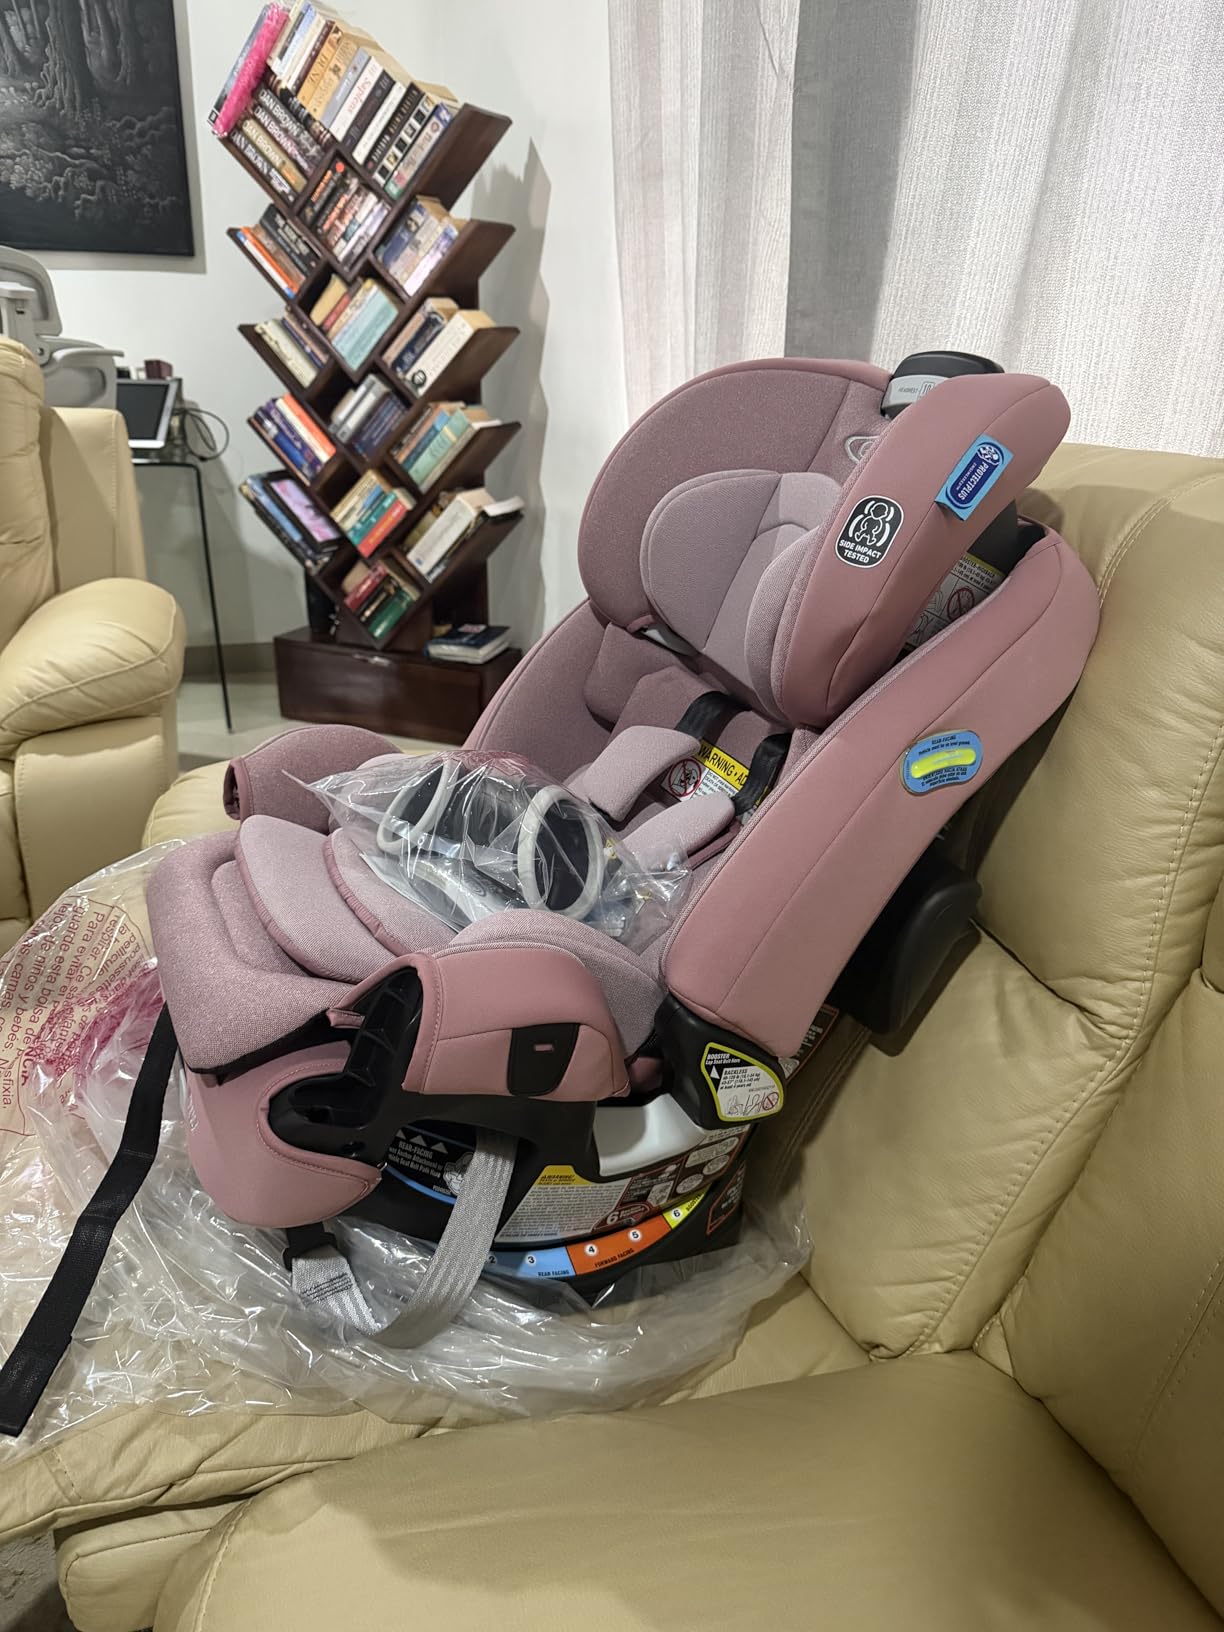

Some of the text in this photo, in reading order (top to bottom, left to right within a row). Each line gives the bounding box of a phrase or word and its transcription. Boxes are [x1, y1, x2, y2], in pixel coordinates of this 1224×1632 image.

[346, 76, 373, 113] Sapiens
[258, 88, 300, 136] DAN BROWN
[241, 119, 258, 139] DAN
[256, 136, 283, 166] BROWN
[253, 105, 270, 126] DAN
[266, 122, 294, 153] BROWN
[957, 461, 989, 500] PROTECTPLUS
[839, 539, 882, 560] SIDE IMPACT
[843, 549, 870, 564] TESTED
[697, 744, 735, 776] WARNING
[50, 903, 68, 931] lejos
[59, 905, 85, 953] guarde
[84, 911, 105, 943] Para
[23, 955, 47, 992] niños
[45, 954, 66, 985] esta
[65, 946, 86, 982] evitar
[74, 964, 92, 984] Ce
[0, 961, 25, 1012] camas,
[17, 992, 30, 1004] y
[28, 987, 54, 1025] bolsa
[0, 1006, 29, 1054] bebés.
[21, 1026, 36, 1045] de
[398, 1141, 433, 1158] REAR-FACING
[606, 1212, 619, 1224] 6
[672, 1208, 681, 1218] 6
[587, 1245, 595, 1253] 4
[631, 1230, 639, 1239] 5
[488, 1255, 495, 1263] 2
[594, 1247, 634, 1267] FORWARD FACING
